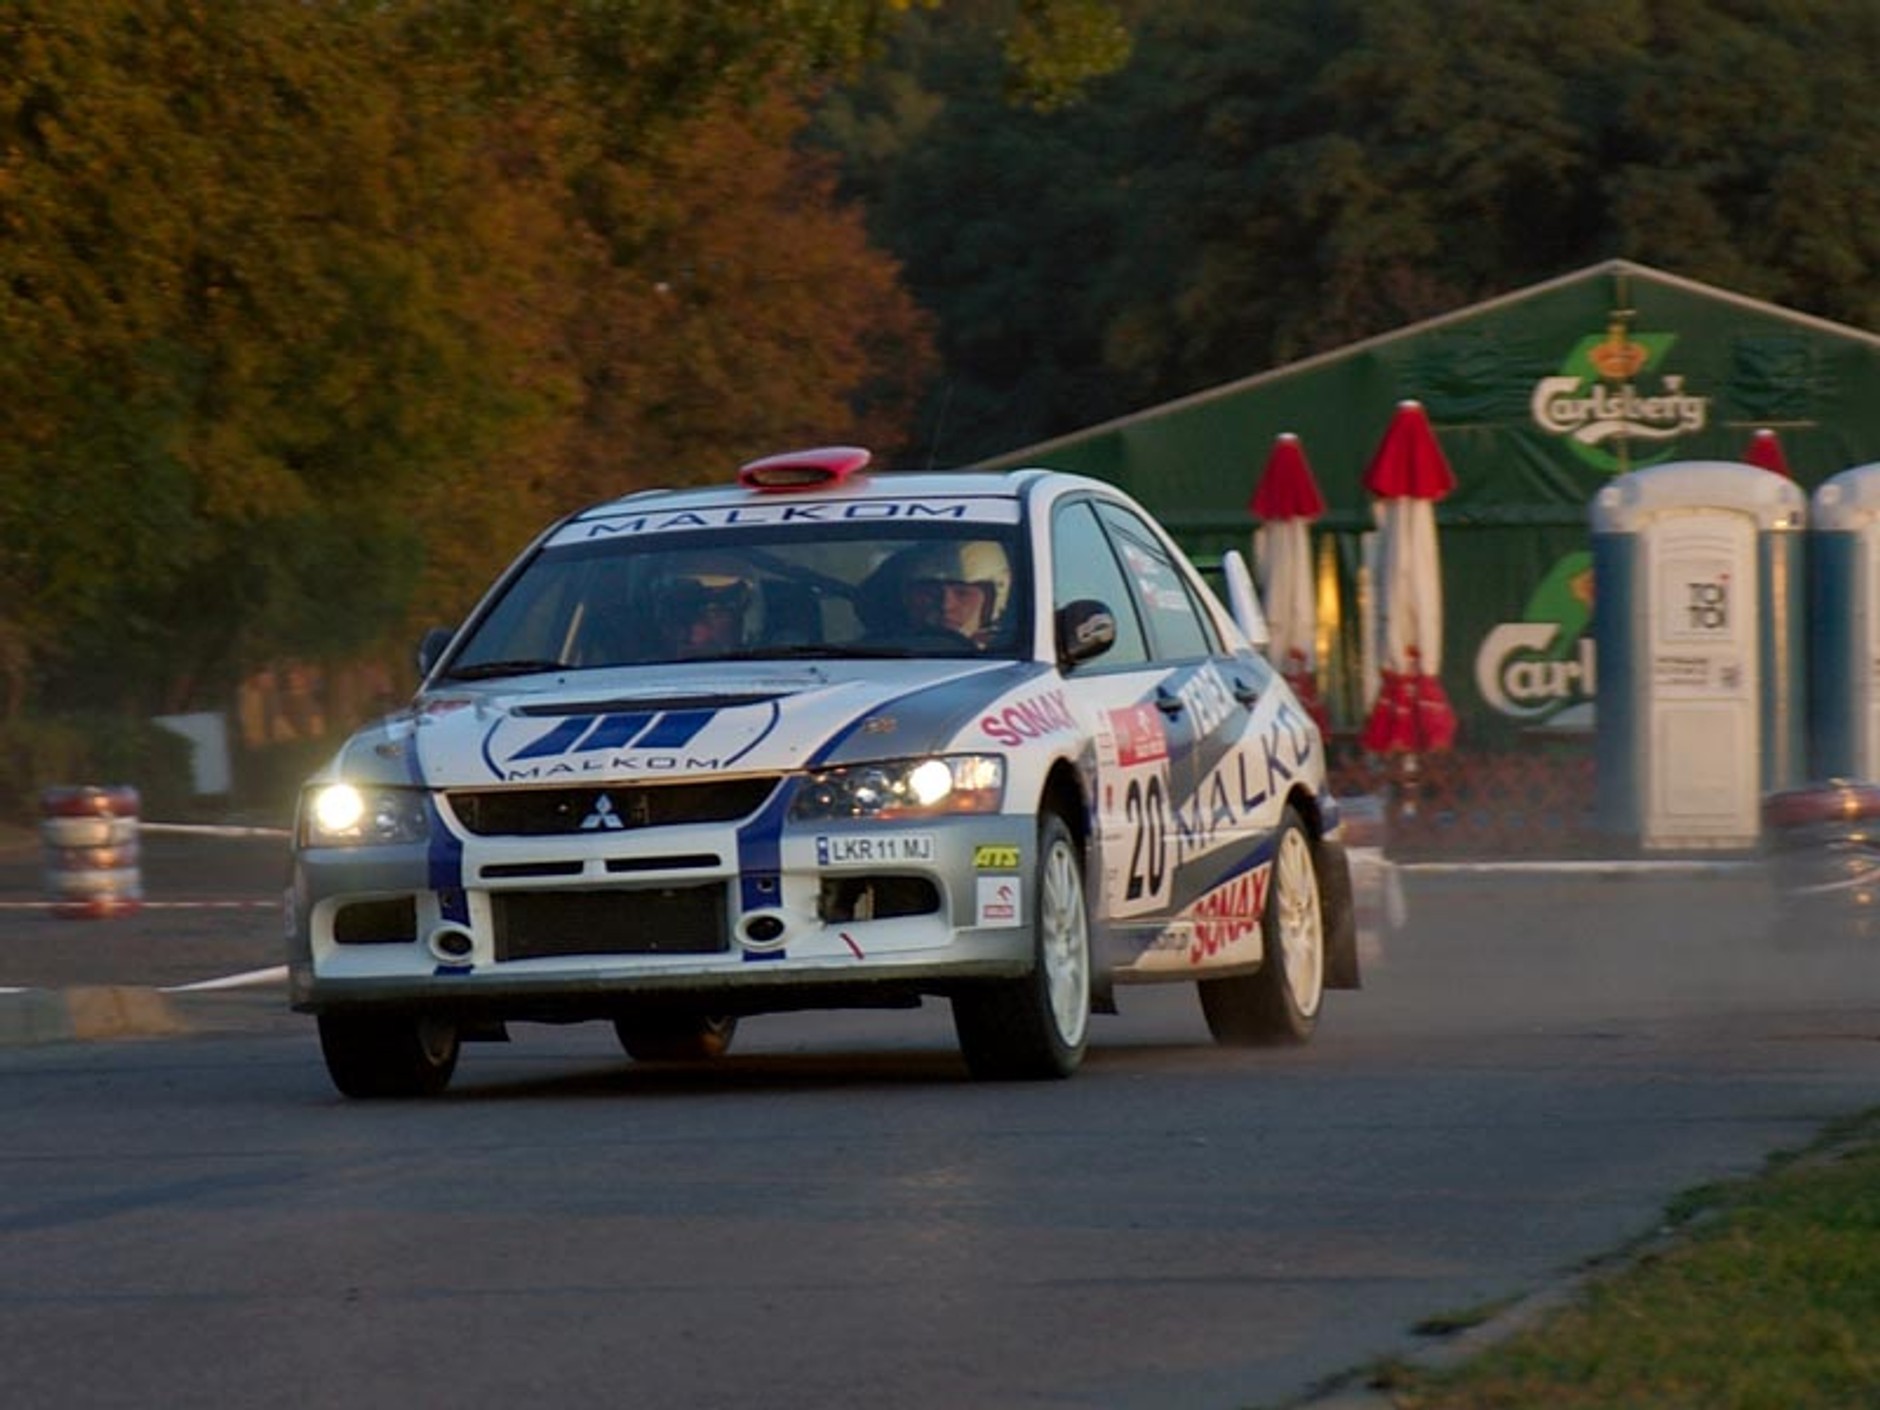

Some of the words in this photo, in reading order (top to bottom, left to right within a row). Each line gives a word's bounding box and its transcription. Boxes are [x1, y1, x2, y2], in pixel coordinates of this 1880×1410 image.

[1532, 375, 1712, 442] Carlsberg
[586, 503, 968, 538] MALKOM
[1475, 621, 1596, 717] Carl
[980, 689, 1079, 747] SONAX
[507, 756, 723, 781] MALKOM
[832, 838, 873, 861] LKR
[877, 838, 897, 859] 11
[903, 837, 930, 859] MJ
[1125, 773, 1167, 901] 20
